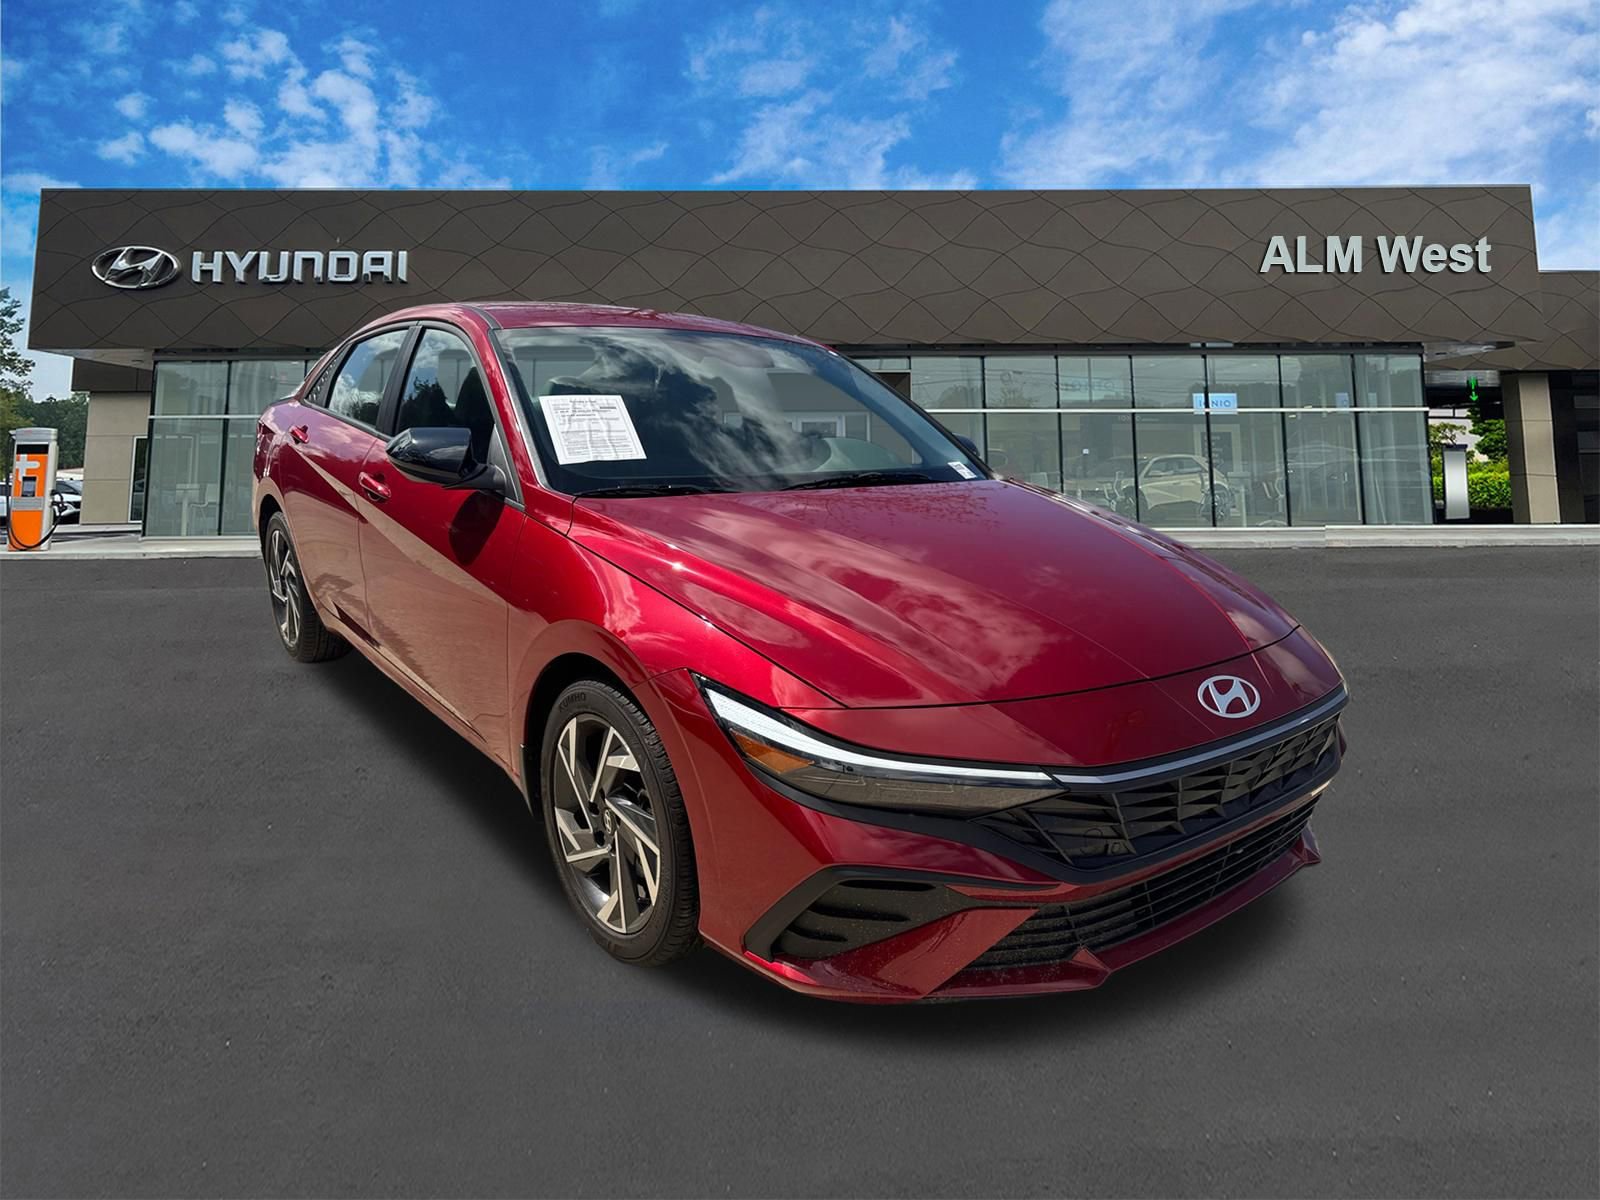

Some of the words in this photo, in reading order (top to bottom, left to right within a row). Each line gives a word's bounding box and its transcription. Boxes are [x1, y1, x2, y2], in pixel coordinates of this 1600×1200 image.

[191, 250, 409, 283] HYUNDAI
[1260, 235, 1363, 273] ALM
[1377, 235, 1492, 273] West
